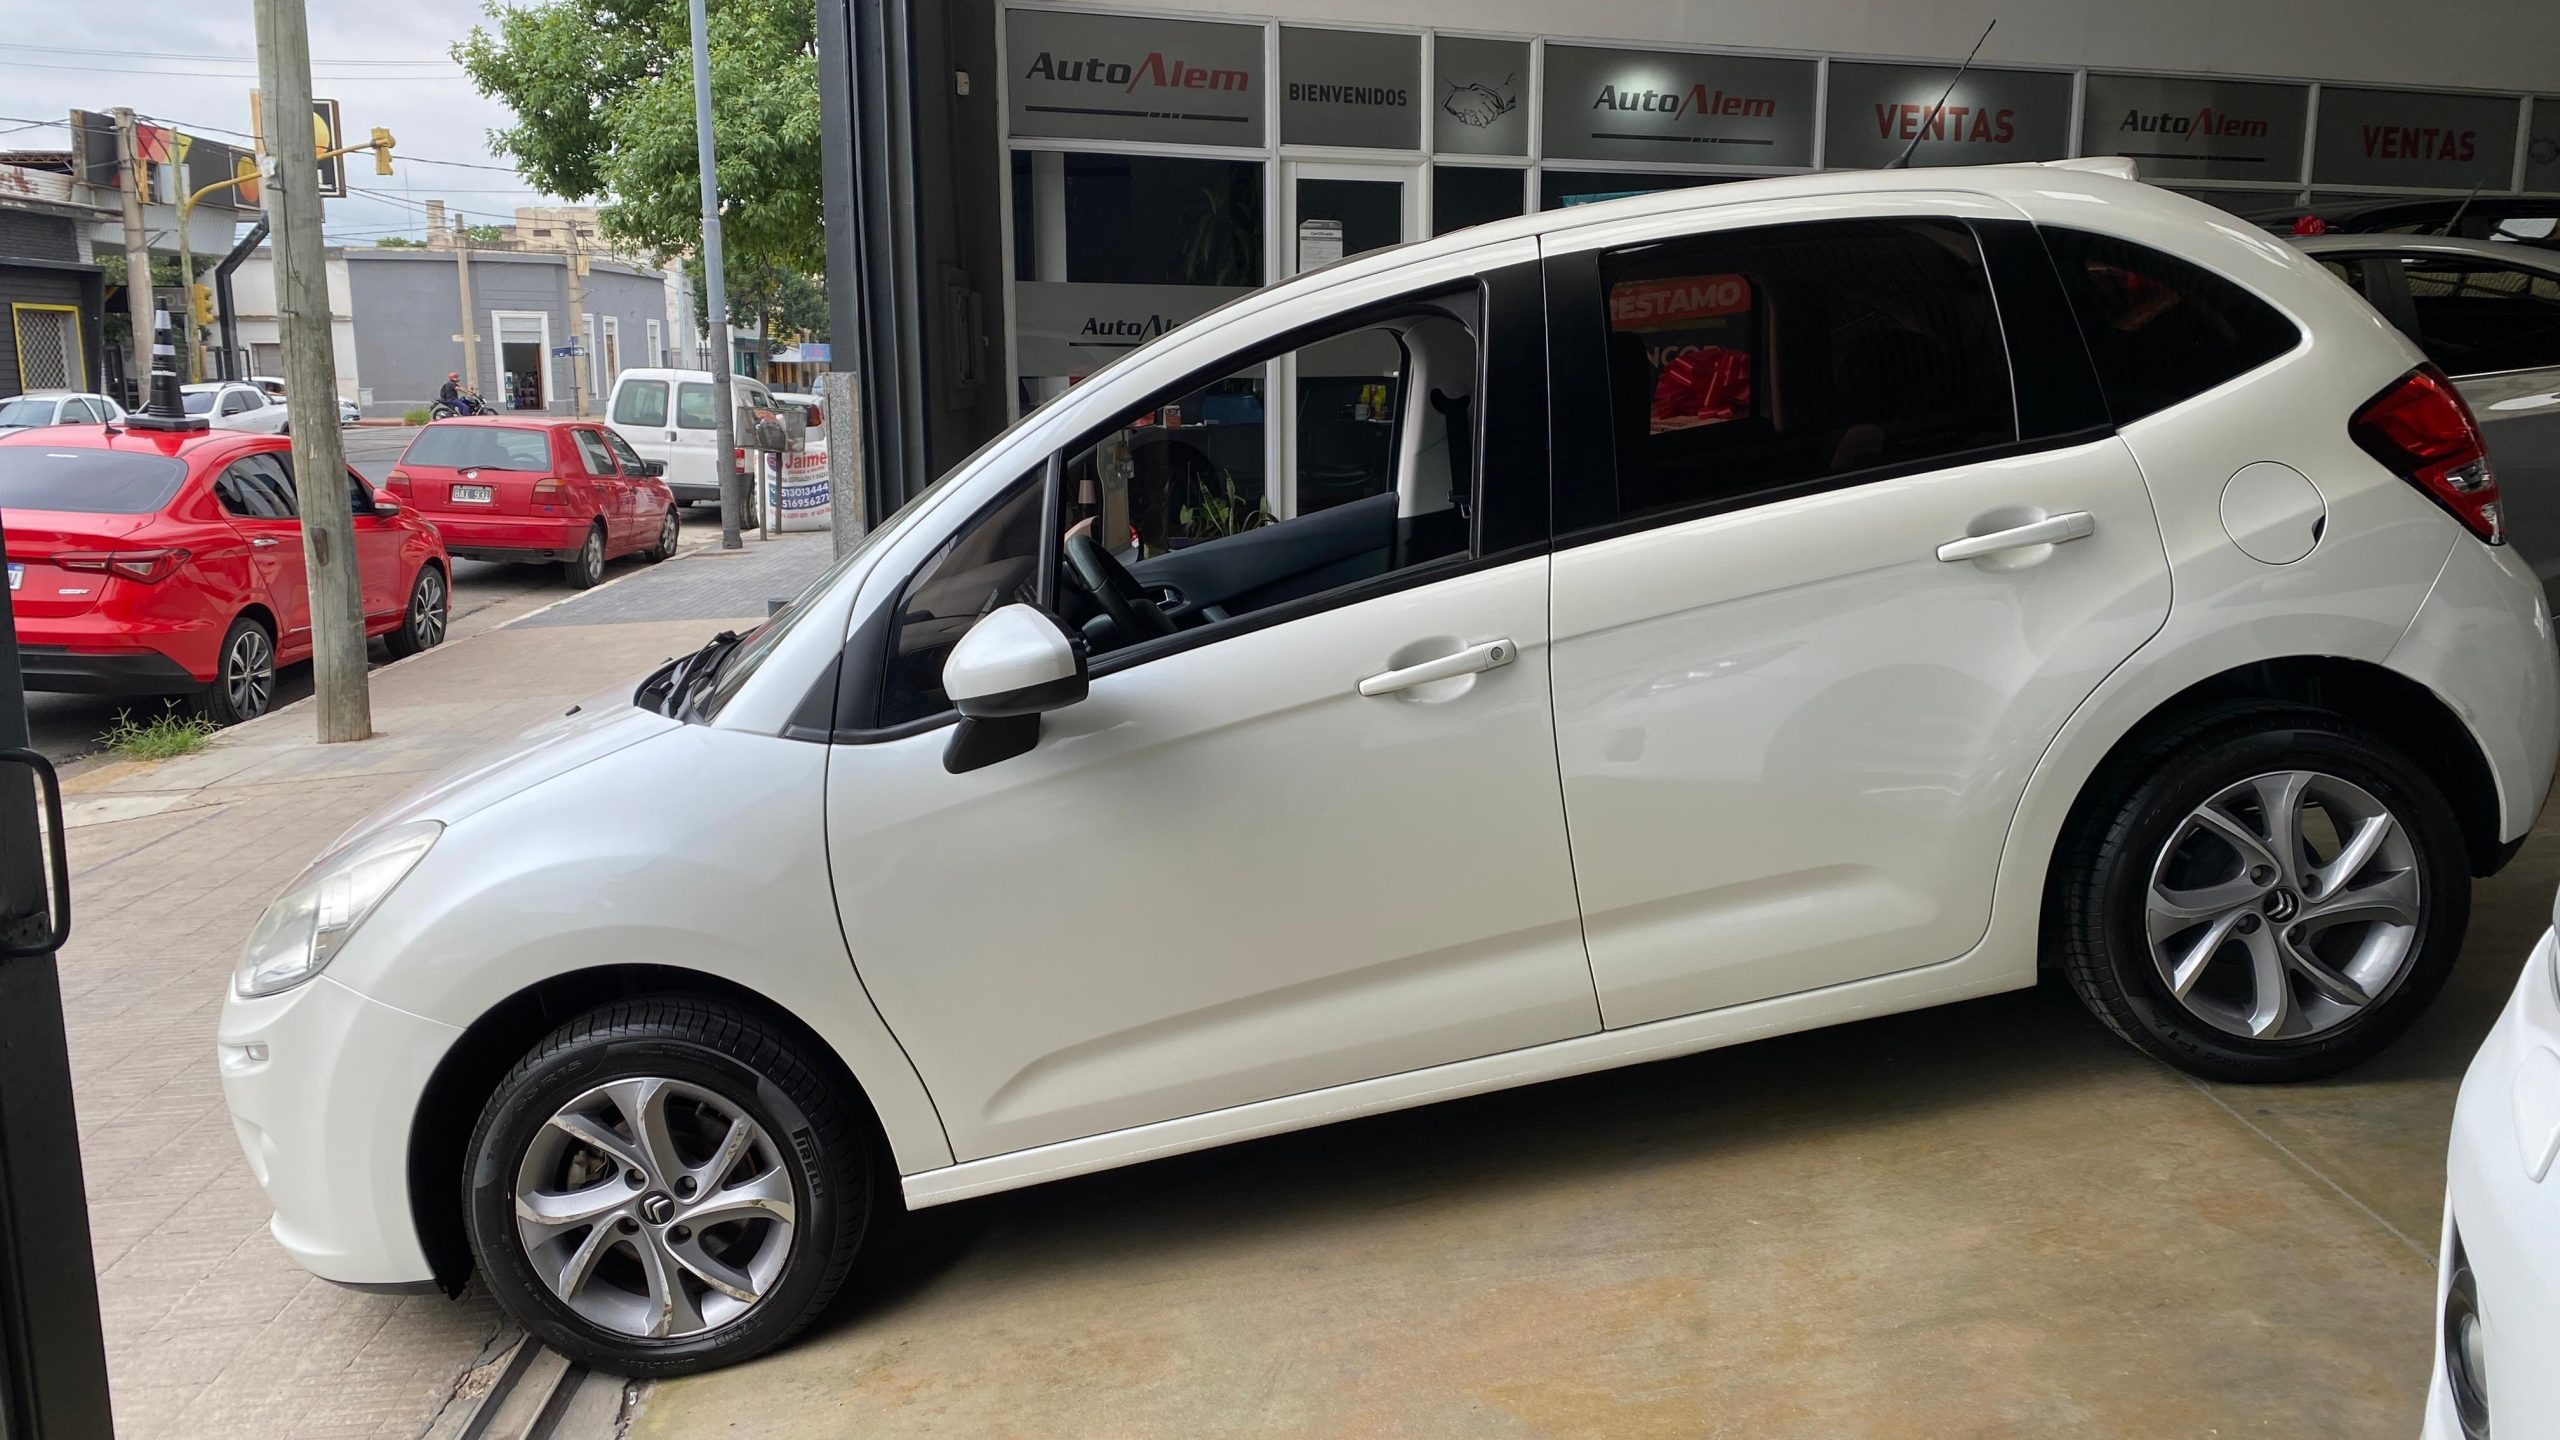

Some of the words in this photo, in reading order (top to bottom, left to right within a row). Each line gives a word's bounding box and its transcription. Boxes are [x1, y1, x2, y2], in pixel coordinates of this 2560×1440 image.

[1288, 82, 1408, 107] BIENVENIDOS
[1875, 103, 2015, 144] VENTAS
[2362, 125, 2477, 161] VENTAS
[785, 451, 828, 470] Jaime
[792, 1126, 825, 1199] PIRELLI
